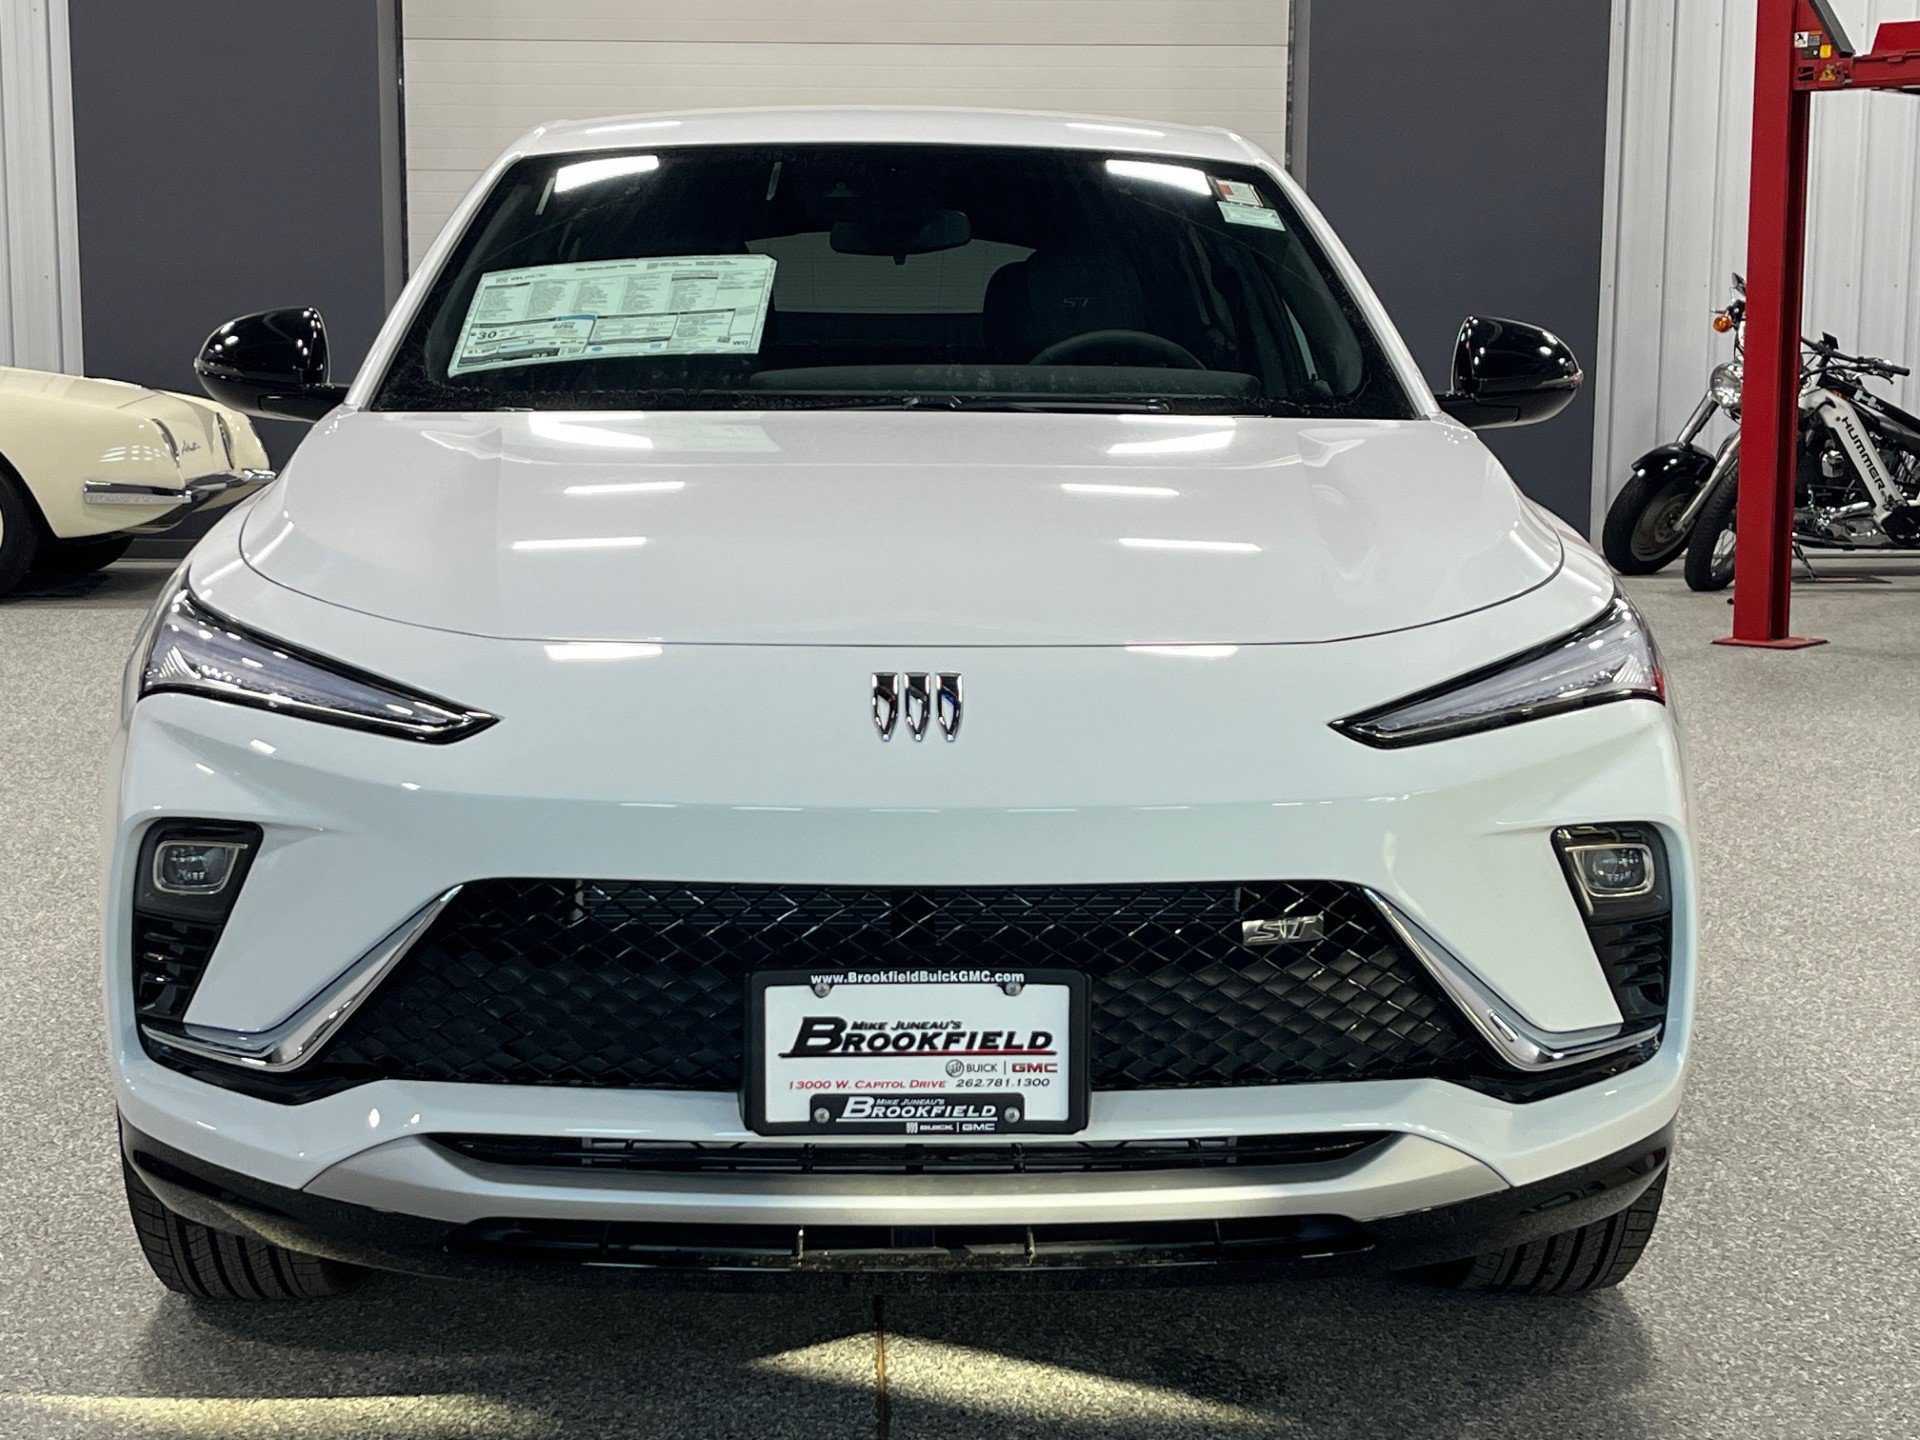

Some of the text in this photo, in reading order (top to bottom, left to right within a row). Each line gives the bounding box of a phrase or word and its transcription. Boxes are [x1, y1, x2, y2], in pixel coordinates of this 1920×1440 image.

[477, 331, 498, 340] 30
[1842, 416, 1886, 491] HUMMER
[811, 970, 1025, 984] www.BrookfieldBuickGMC.com
[788, 1016, 1054, 1057] BROOKFIELD
[966, 1063, 1058, 1073] BUICK GMC
[789, 1080, 832, 1090] 13000
[955, 1078, 1050, 1088] 262.781.1300
[841, 1096, 996, 1118] BROOKFIELD
[919, 1123, 995, 1131] BUICK GMC
